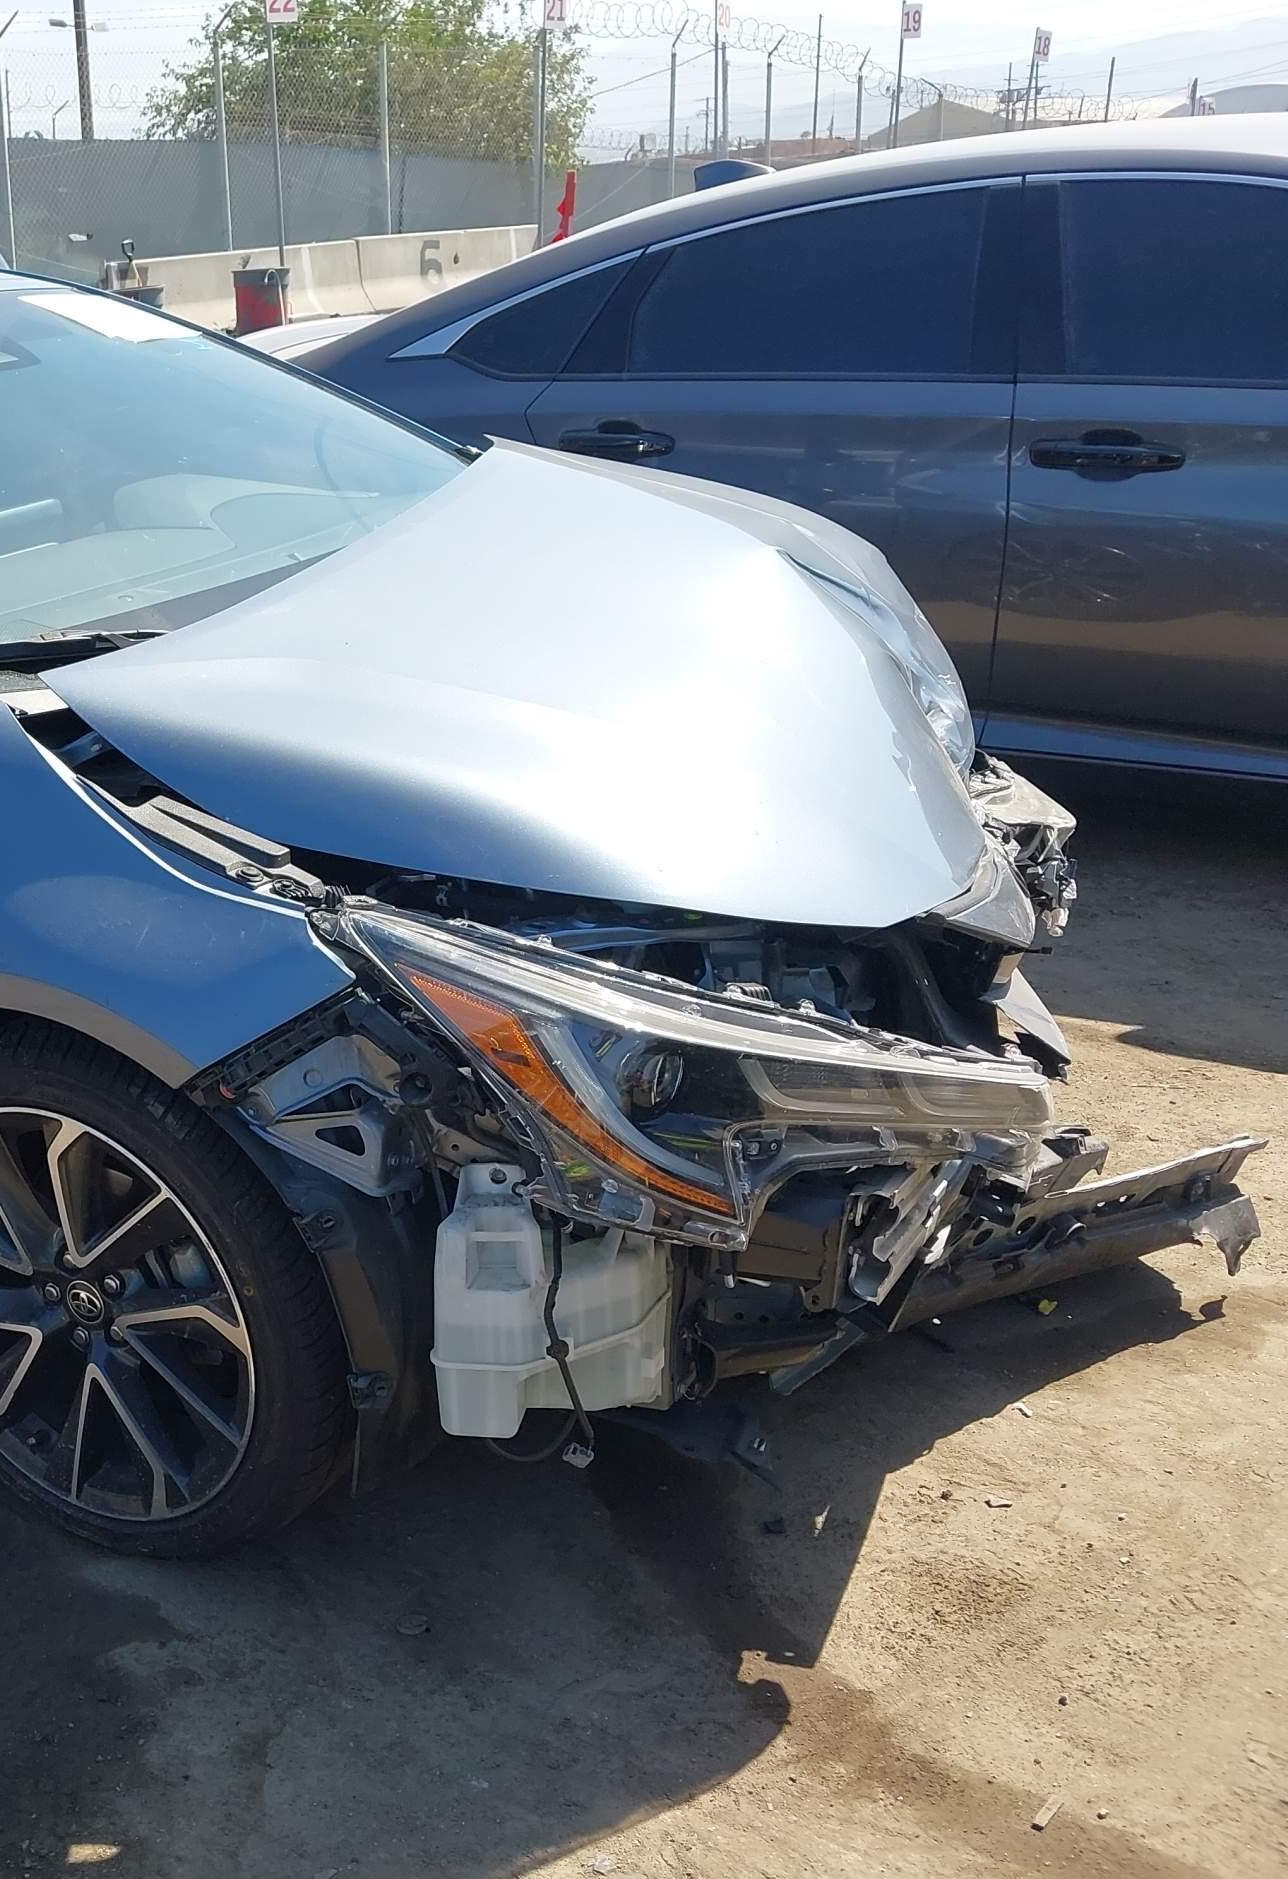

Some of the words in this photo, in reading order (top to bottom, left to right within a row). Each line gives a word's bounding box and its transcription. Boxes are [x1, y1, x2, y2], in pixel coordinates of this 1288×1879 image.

[547, 0, 565, 21] 21
[718, 3, 731, 28] 20
[904, 10, 921, 32] 19
[1035, 36, 1050, 56] 18
[420, 240, 443, 287] 6
